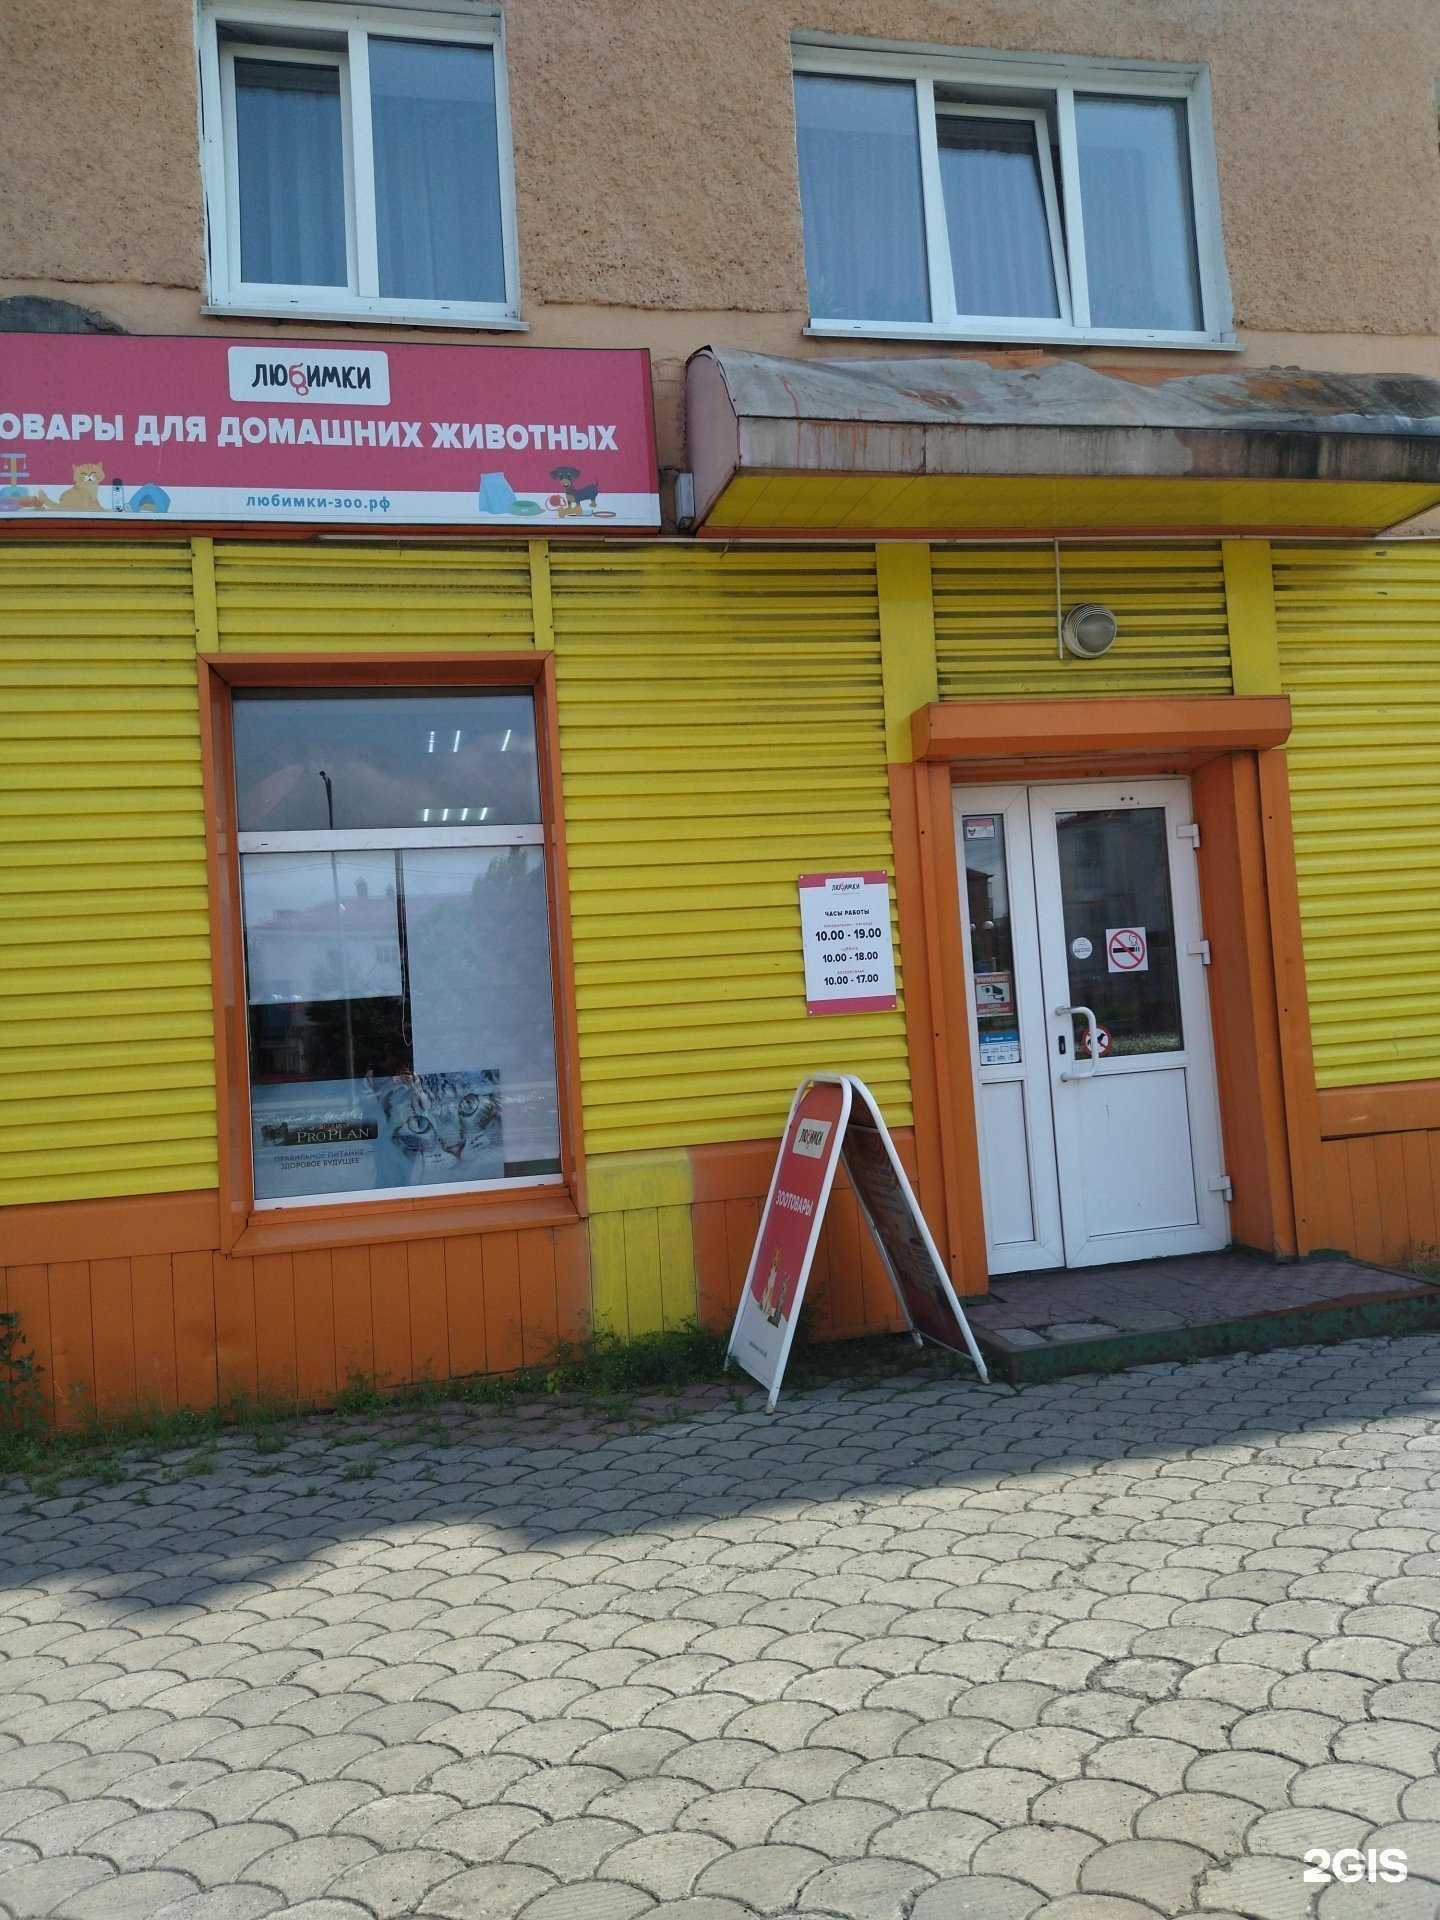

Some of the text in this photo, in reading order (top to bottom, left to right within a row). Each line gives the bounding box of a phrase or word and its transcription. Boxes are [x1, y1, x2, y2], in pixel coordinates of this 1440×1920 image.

[0, 412, 619, 451] ОВАРЫ ДЛЯ ДОМАШНИХ ЖИВОТНЫХ
[245, 493, 391, 512] любимки-зоо.рф
[824, 908, 870, 917] ЧАСЫ РАБОТЫ
[815, 929, 845, 942] 10.00
[854, 927, 882, 940] 19.00
[822, 953, 847, 963] 10.00
[854, 951, 879, 961] 18.00
[824, 976, 849, 986] 10.00
[856, 974, 879, 984] 17.00
[775, 1190, 814, 1216] ЗООТОВАРЫ
